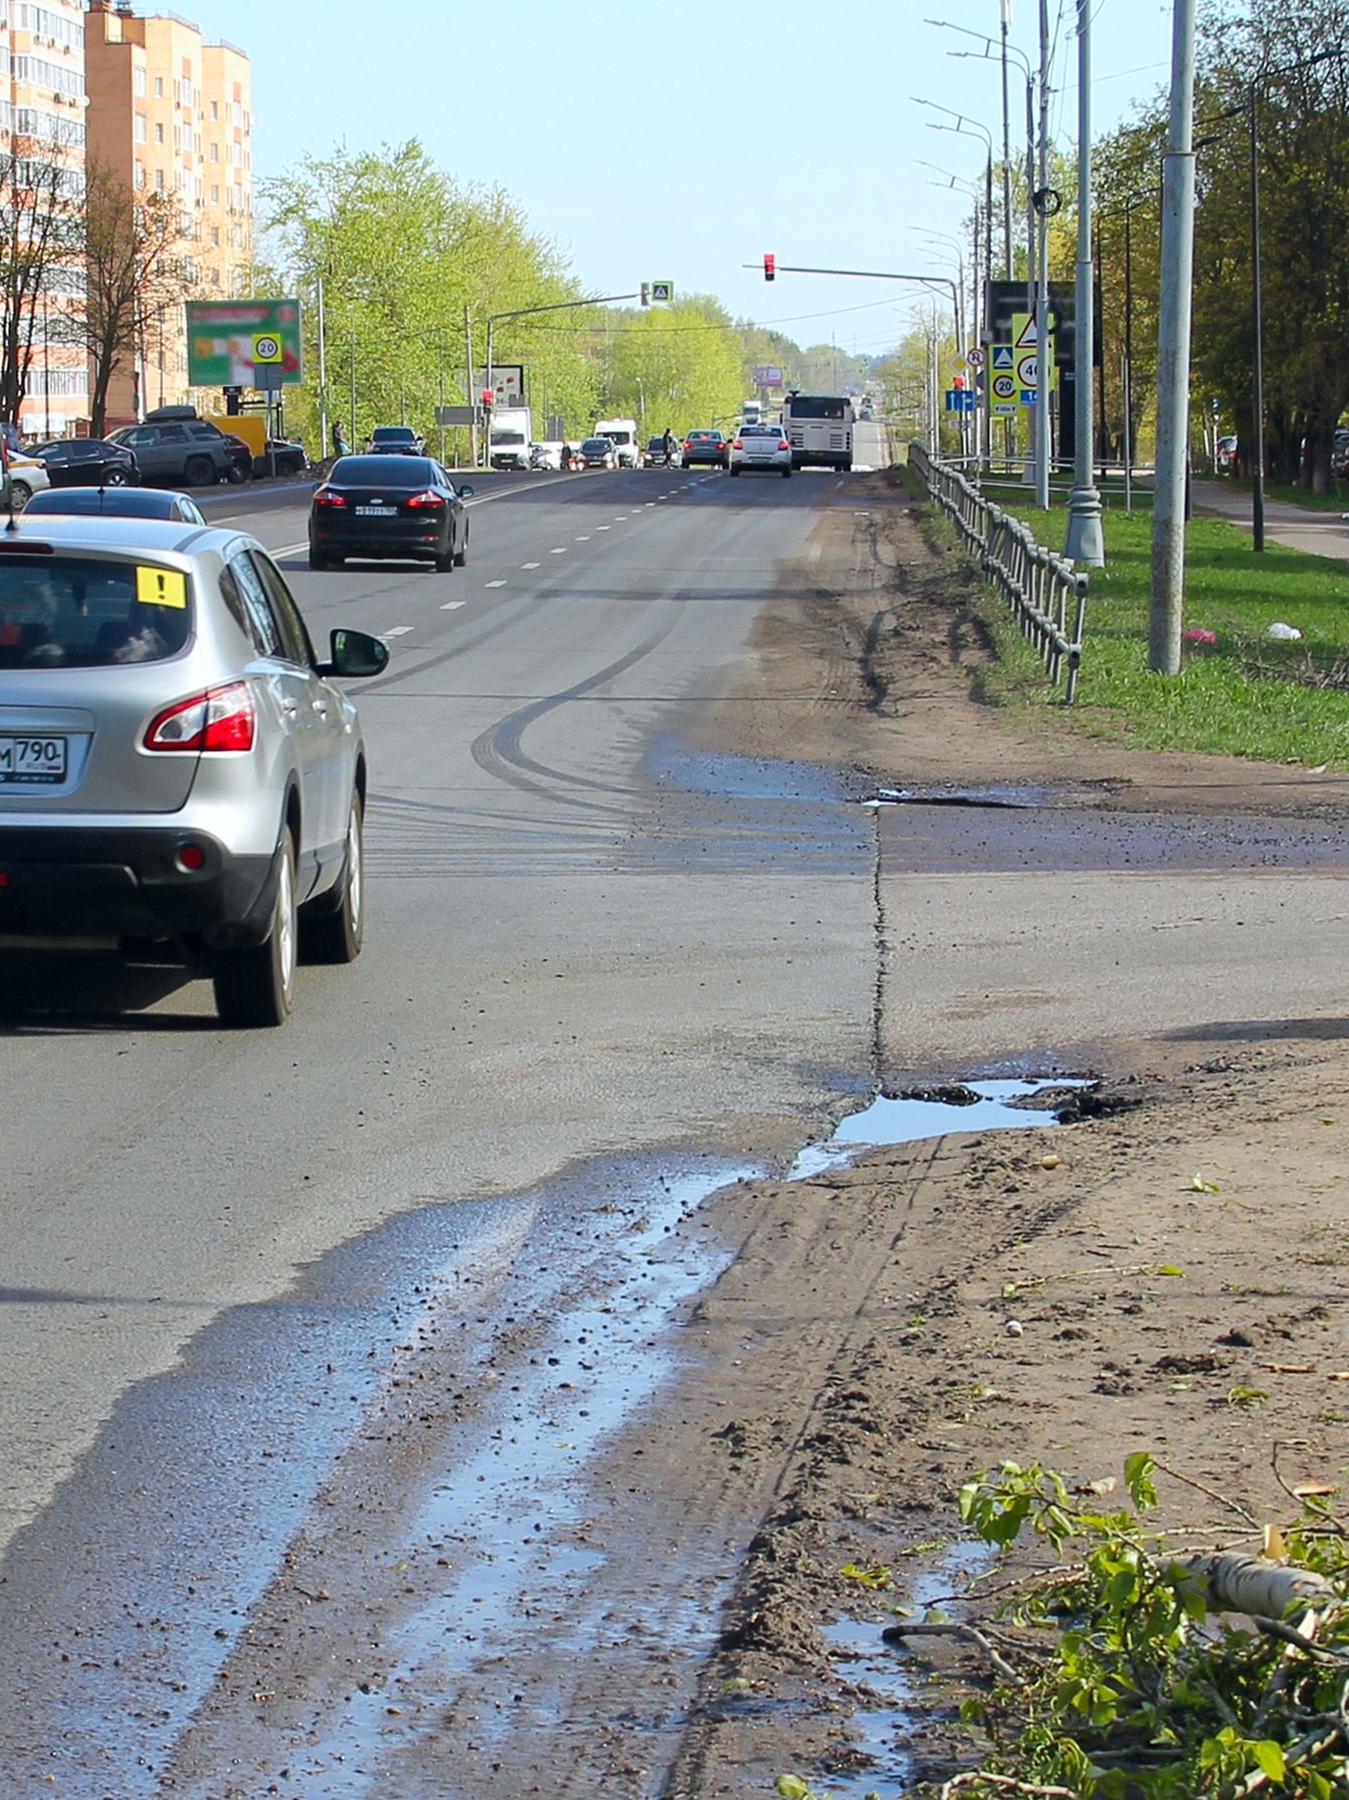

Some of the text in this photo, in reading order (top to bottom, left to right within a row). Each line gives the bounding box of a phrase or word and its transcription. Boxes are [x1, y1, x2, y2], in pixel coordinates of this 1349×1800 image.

[260, 343, 275, 353] 20
[998, 381, 1012, 392] 20
[16, 740, 57, 762] 790
